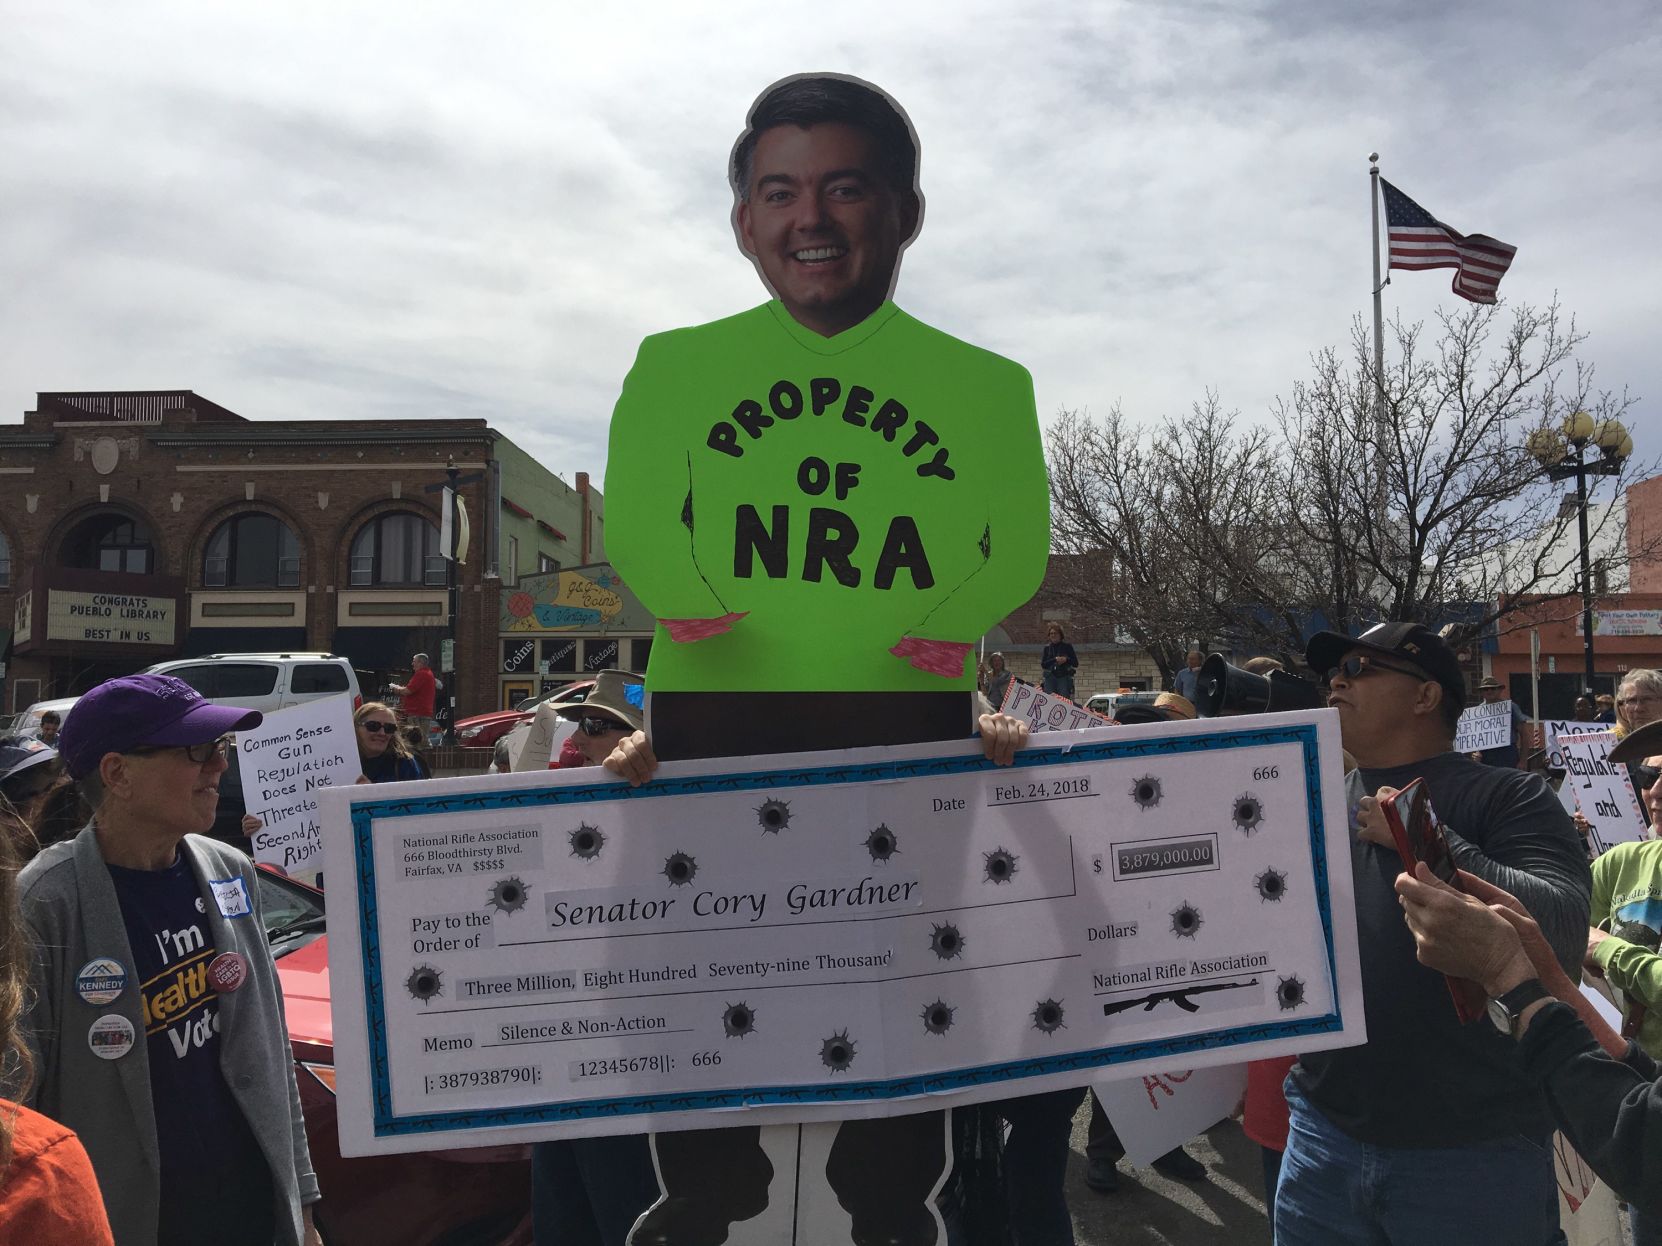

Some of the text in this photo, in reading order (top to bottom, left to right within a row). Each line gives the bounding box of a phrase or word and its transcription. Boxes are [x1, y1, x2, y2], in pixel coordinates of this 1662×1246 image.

[707, 378, 955, 480] PROPERTY
[797, 456, 861, 500] OF
[734, 504, 935, 590] NRA
[70, 605, 167, 620] PUEBLO LIBRARY
[92, 595, 148, 608] CONGRATS
[84, 628, 151, 641] BEST IN US
[504, 640, 535, 672] Coins
[547, 641, 577, 666] ntiques
[584, 641, 618, 669] Vintage
[1011, 687, 1114, 730] PROT
[1475, 717, 1508, 732] MORAL
[243, 724, 332, 753] Common Sense
[278, 744, 312, 760] Gun
[257, 755, 344, 783] Regulation
[1254, 766, 1278, 780] 666
[262, 774, 333, 801] Does Not
[933, 779, 1088, 812] Date Feb. 24, 2018
[1595, 788, 1622, 818] and
[256, 822, 304, 851] Second
[404, 830, 538, 848] National Rifle Association
[404, 844, 522, 862] 666 Bloodthirsty Blvd.
[1094, 847, 1209, 874] $ 3,879,000.00
[406, 859, 504, 876] Fairfax, VA $$$$$
[552, 877, 918, 927] Senator Cory Gardner
[412, 912, 490, 934] Pay to the
[1088, 925, 1136, 941] Dollars
[155, 925, 205, 965] I'm
[414, 934, 480, 953] Order of
[218, 964, 241, 984] LGBTQ
[465, 950, 892, 995] Three Million, Eight Hundred Seventy-nine Thousand
[1094, 955, 1266, 988] National Rifle Association
[80, 980, 123, 991] KENNEDY
[424, 1016, 666, 1052] Memo Silence & Non-Action
[692, 1051, 721, 1066] 666
